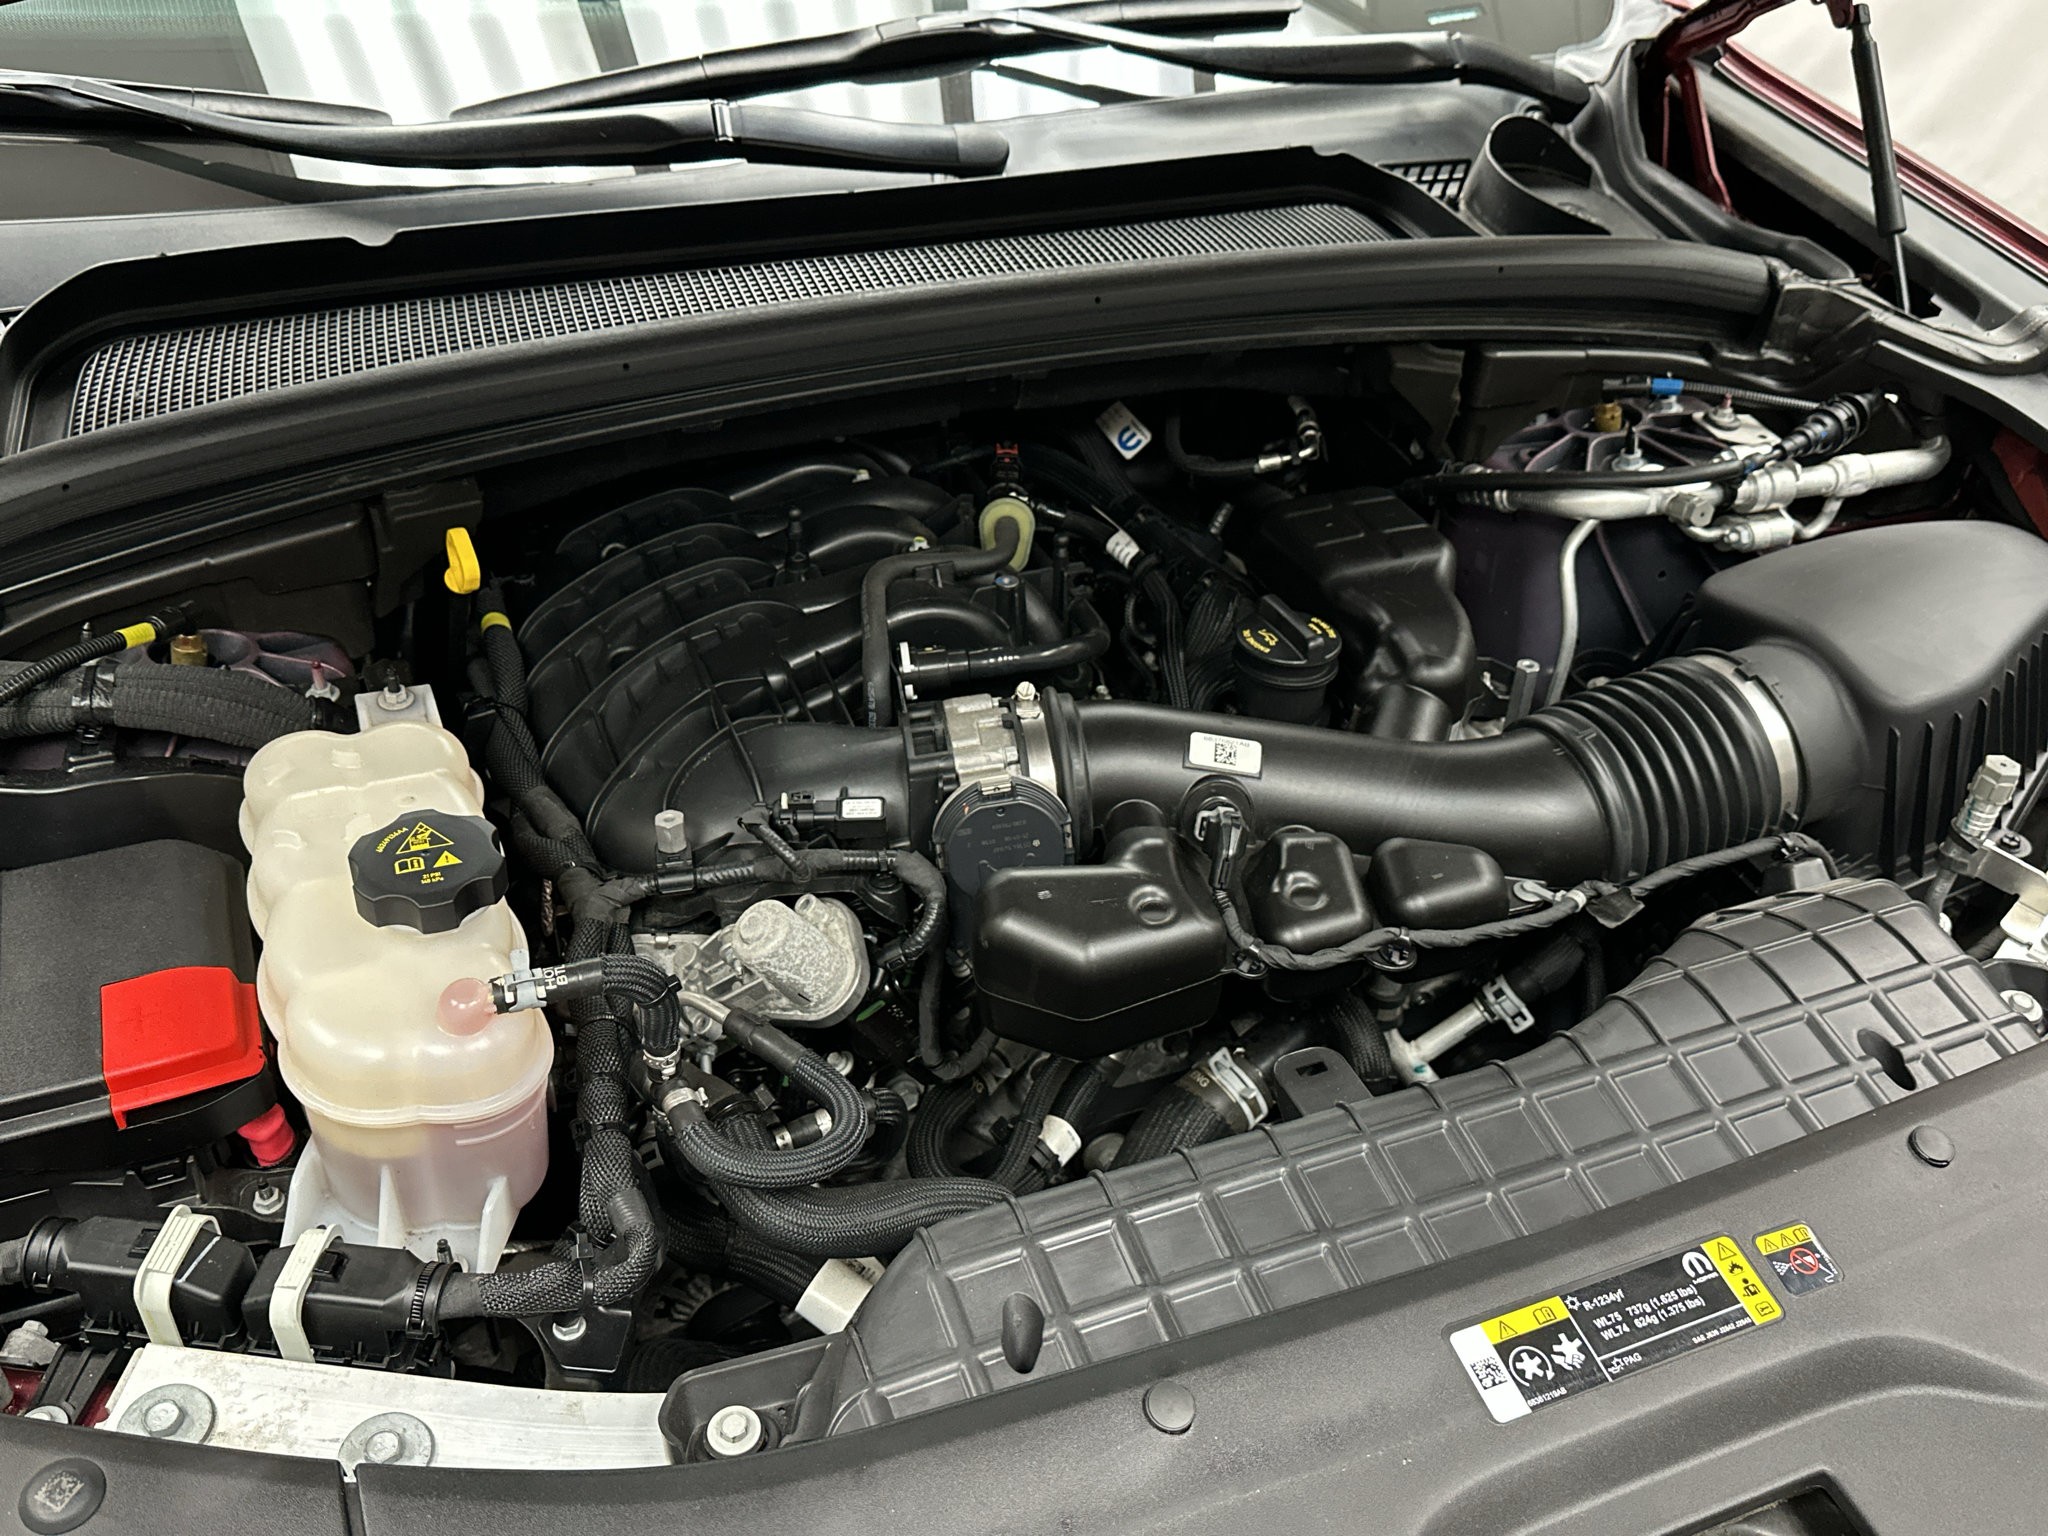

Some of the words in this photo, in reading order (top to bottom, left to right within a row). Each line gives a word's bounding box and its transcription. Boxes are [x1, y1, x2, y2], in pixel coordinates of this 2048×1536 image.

[1582, 1288, 1625, 1312] R-1234yf
[1592, 1311, 1623, 1329] WL75
[1625, 1302, 1653, 1317] 737g
[1649, 1291, 1679, 1310] (1.625
[1677, 1283, 1698, 1298] lbs)
[1600, 1322, 1631, 1341] WL74
[1633, 1314, 1660, 1329] 624g
[1656, 1302, 1687, 1322] (1.375
[1684, 1295, 1706, 1310] lbs)
[1622, 1352, 1643, 1366] PAG
